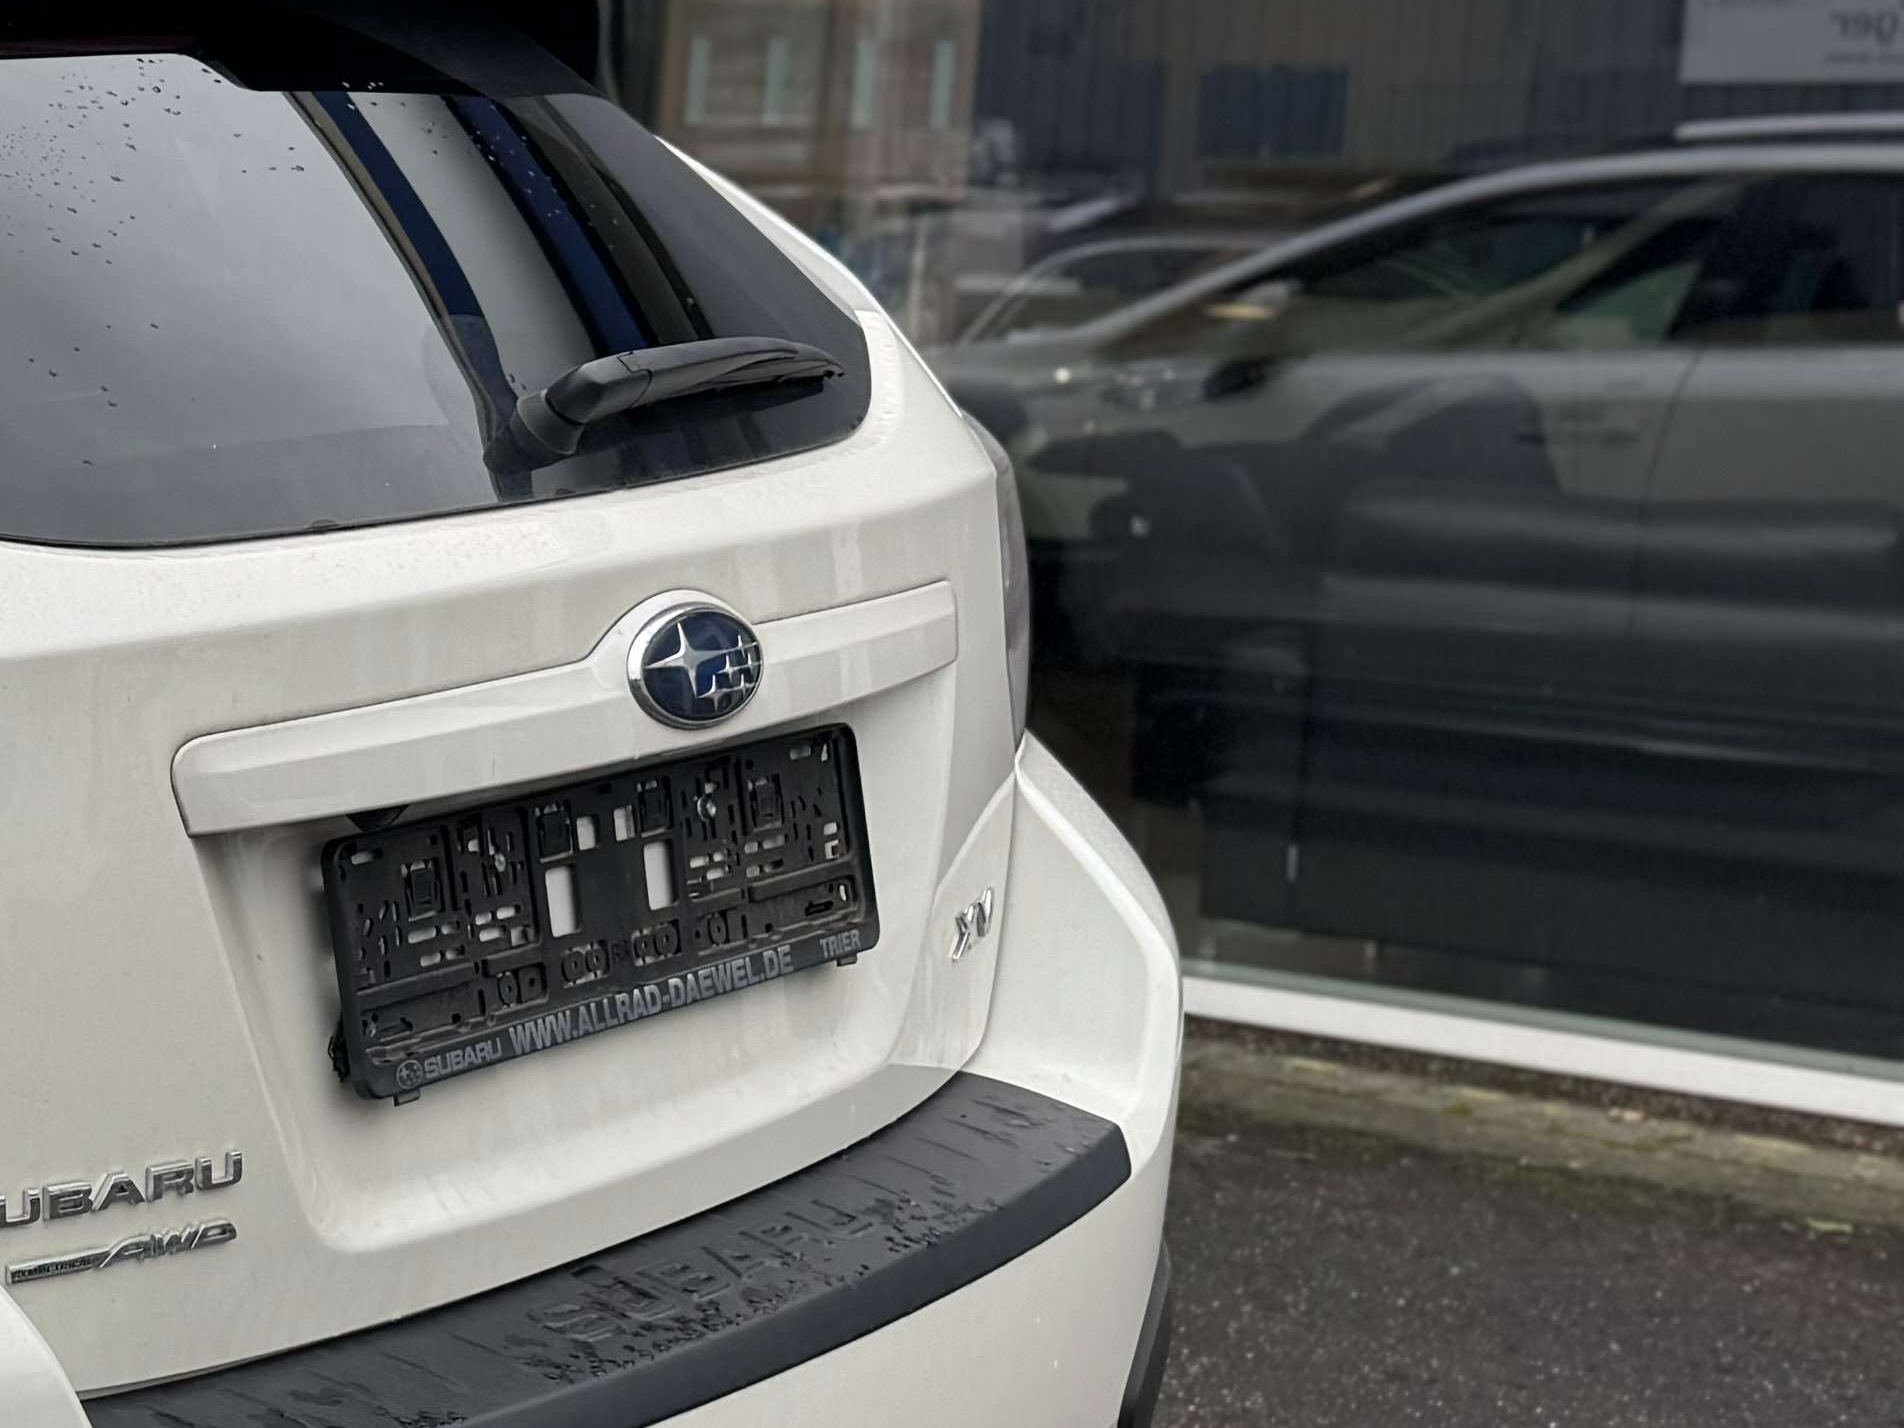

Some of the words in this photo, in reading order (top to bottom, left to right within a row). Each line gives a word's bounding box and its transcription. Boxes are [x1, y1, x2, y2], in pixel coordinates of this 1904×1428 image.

[949, 887, 994, 962] XV
[424, 1039, 502, 1079] SUBARU
[509, 944, 794, 1056] WWW.ALLRAD-DAEWEL.DE
[819, 929, 861, 959] TRIER
[99, 1217, 239, 1269] AWD
